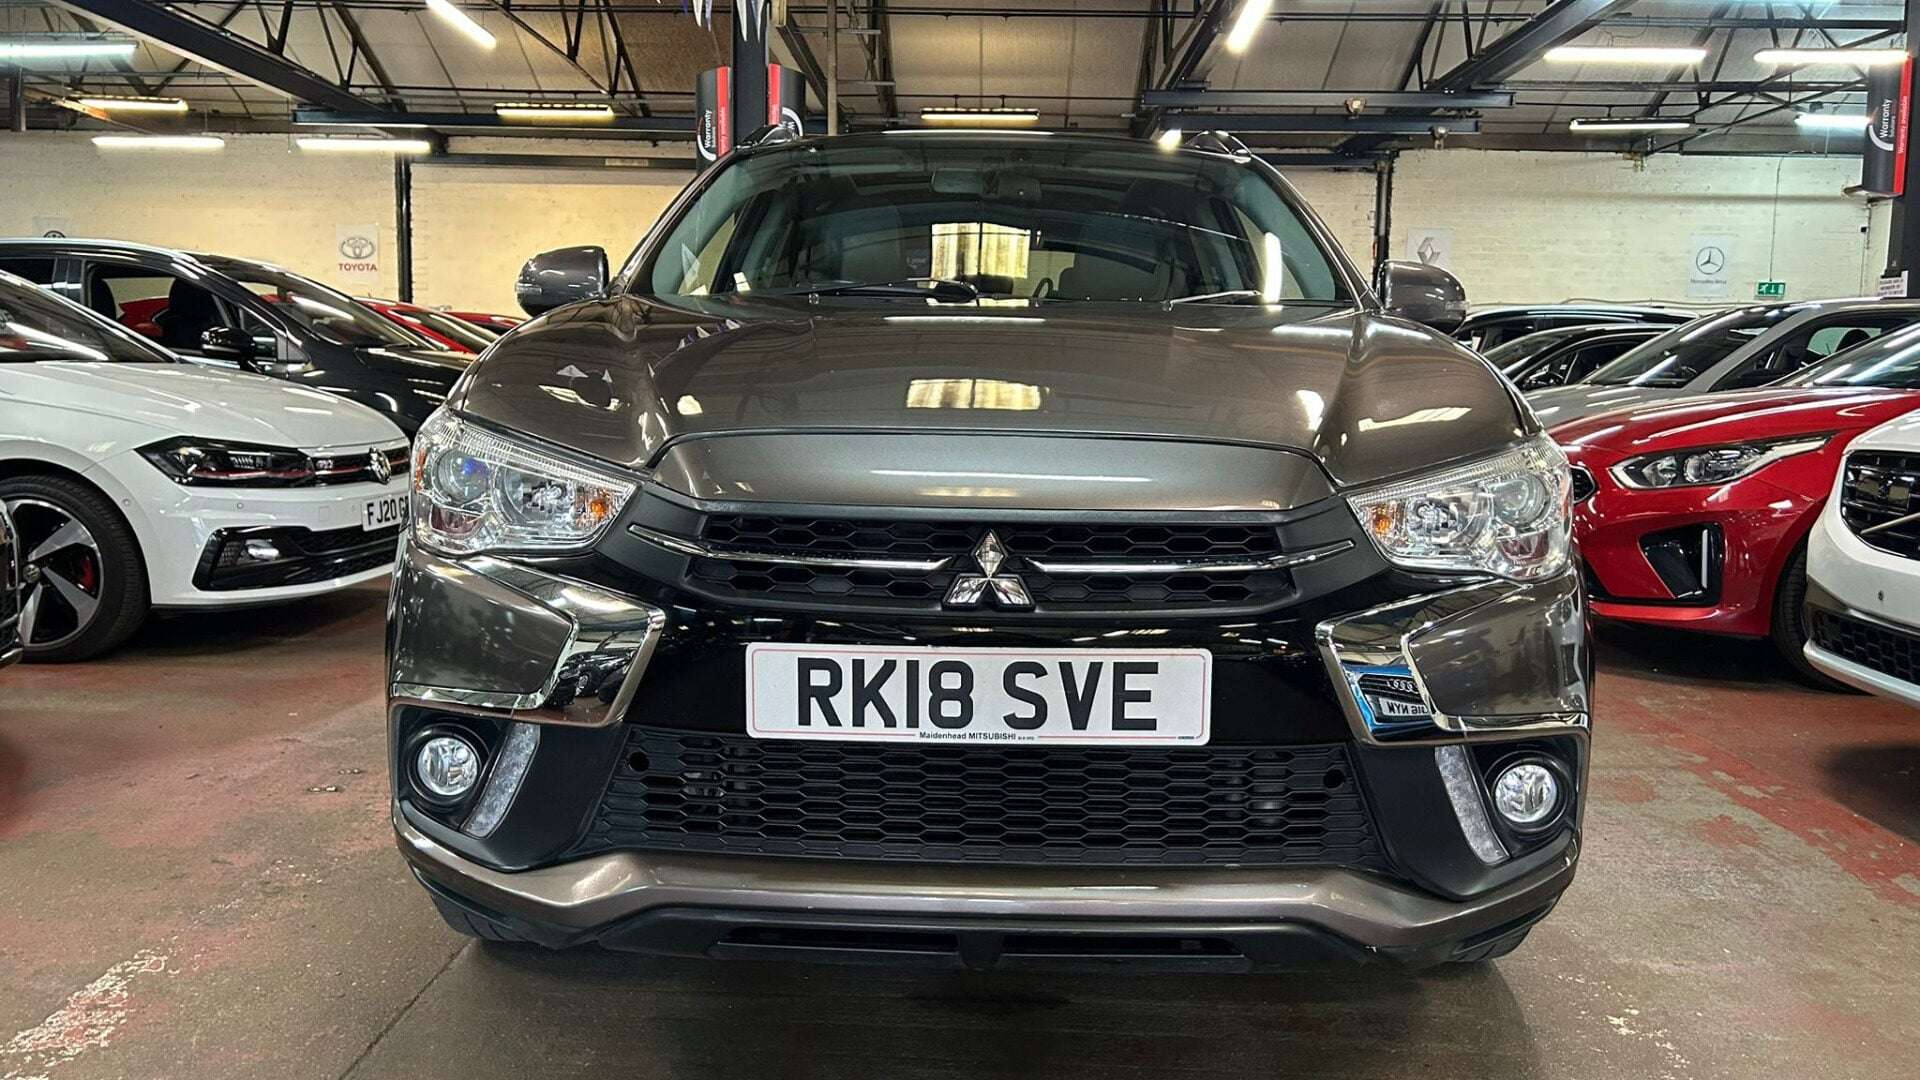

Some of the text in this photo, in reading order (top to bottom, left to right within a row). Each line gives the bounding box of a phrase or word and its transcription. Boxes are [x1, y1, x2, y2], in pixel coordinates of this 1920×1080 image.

[705, 109, 713, 148] Warranty
[1880, 98, 1893, 138] Warranty
[338, 263, 378, 272] TOYOTA
[367, 499, 398, 526] FJ20
[797, 656, 1159, 731] RK18 SVE
[919, 731, 966, 740] Maidenhead
[968, 732, 1017, 741] MITSUBISHI
